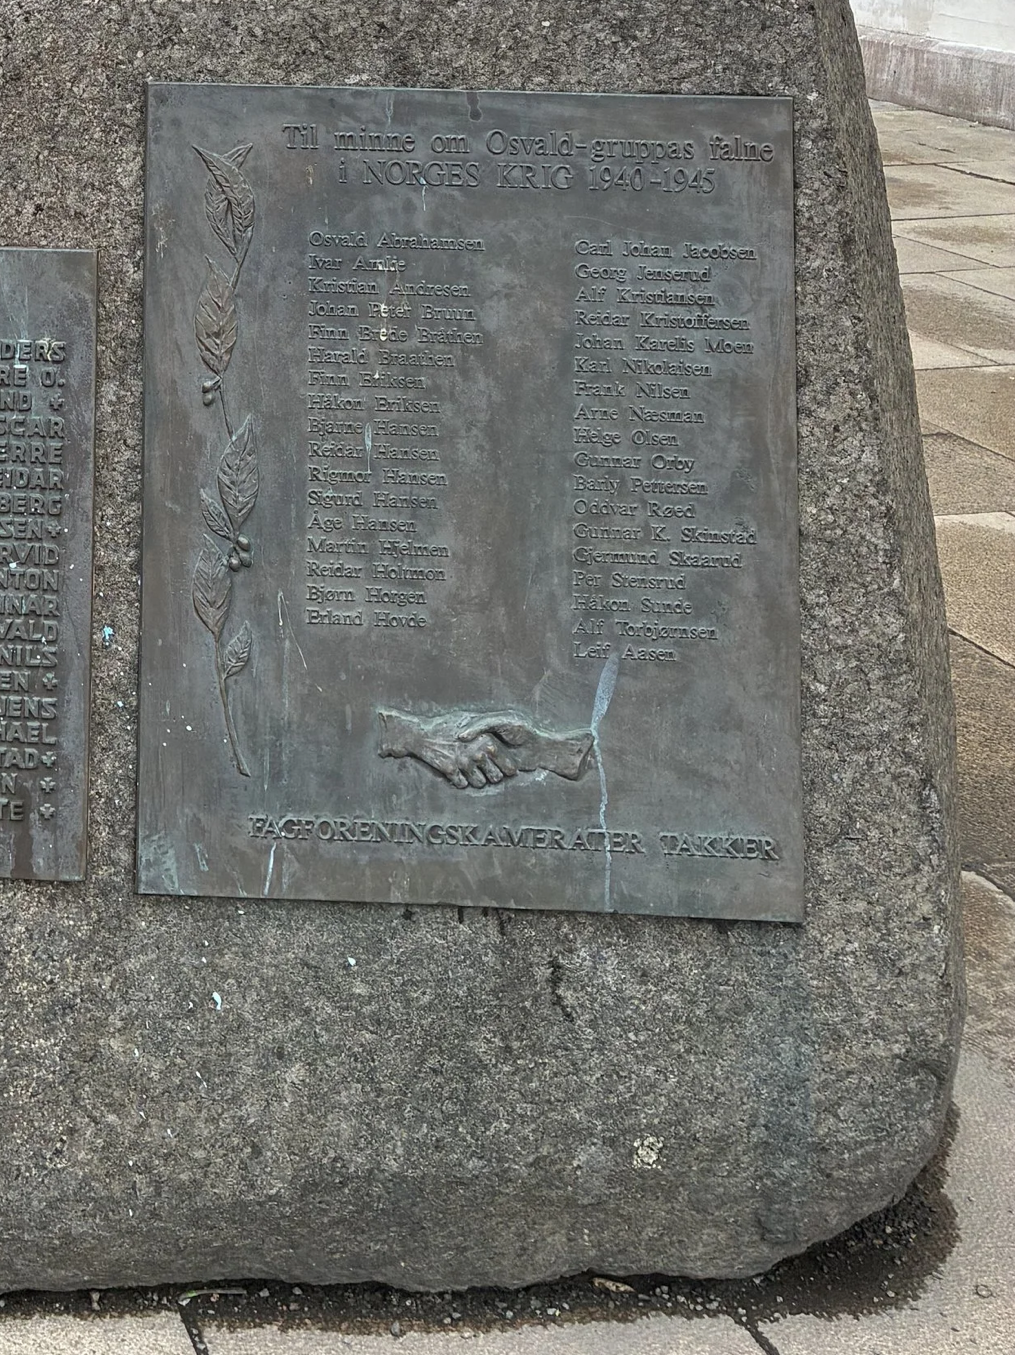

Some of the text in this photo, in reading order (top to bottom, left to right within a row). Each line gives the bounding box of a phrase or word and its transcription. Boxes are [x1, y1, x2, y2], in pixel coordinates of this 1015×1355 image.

[282, 123, 776, 164] Til minne om Osvald-gruppas falne
[361, 159, 482, 190] NORGES
[495, 163, 575, 192] KRIG
[308, 230, 486, 251] Osvald Abrahamsen
[574, 238, 757, 260] Carl Johan Jacobsen
[308, 253, 341, 270] Ivar
[574, 262, 627, 282] Georg
[308, 276, 471, 297] Kristian Andresen
[574, 285, 715, 306] Alf Kristiansen
[307, 300, 477, 321] Johan Peter Bruun
[574, 308, 750, 331] Reidar Kristoffersen
[308, 323, 349, 340] Finn
[574, 332, 625, 351] Johan
[704, 336, 754, 355] Moen
[308, 345, 455, 368] Harald Braathen
[574, 355, 712, 377] Karl Nikolaisen
[307, 369, 426, 389] Finn Eriksen
[573, 379, 691, 400] Frank Nilsen
[374, 394, 441, 414] Eriksen
[574, 402, 618, 421] Arne
[307, 416, 439, 438] Bjarne Hansen
[573, 426, 680, 448] Helge Olsen
[307, 439, 440, 461] Reidar Hansen
[573, 450, 642, 469] Gunnar
[307, 464, 448, 487] Rigmor Hansen
[630, 476, 708, 496] Pettersen
[307, 487, 438, 510] Sigurd Hansen
[572, 497, 638, 517] Oddvar
[351, 513, 418, 534] Hansen
[572, 521, 641, 541] Gunnar
[680, 525, 757, 546] Skinstad
[306, 535, 450, 559] Martin Hjelmen
[572, 544, 743, 571] Gjermund Skaarud
[306, 558, 362, 579] Reidar
[572, 569, 686, 591] Per Stensrud
[364, 585, 427, 608] Horgen
[640, 595, 693, 615] Sunde
[306, 608, 427, 629] Erland Hovde
[572, 617, 604, 636] Alf
[572, 640, 678, 663] Leif Aasen
[248, 814, 781, 861] FAGFORENINGSKAMERATER TAKKER
